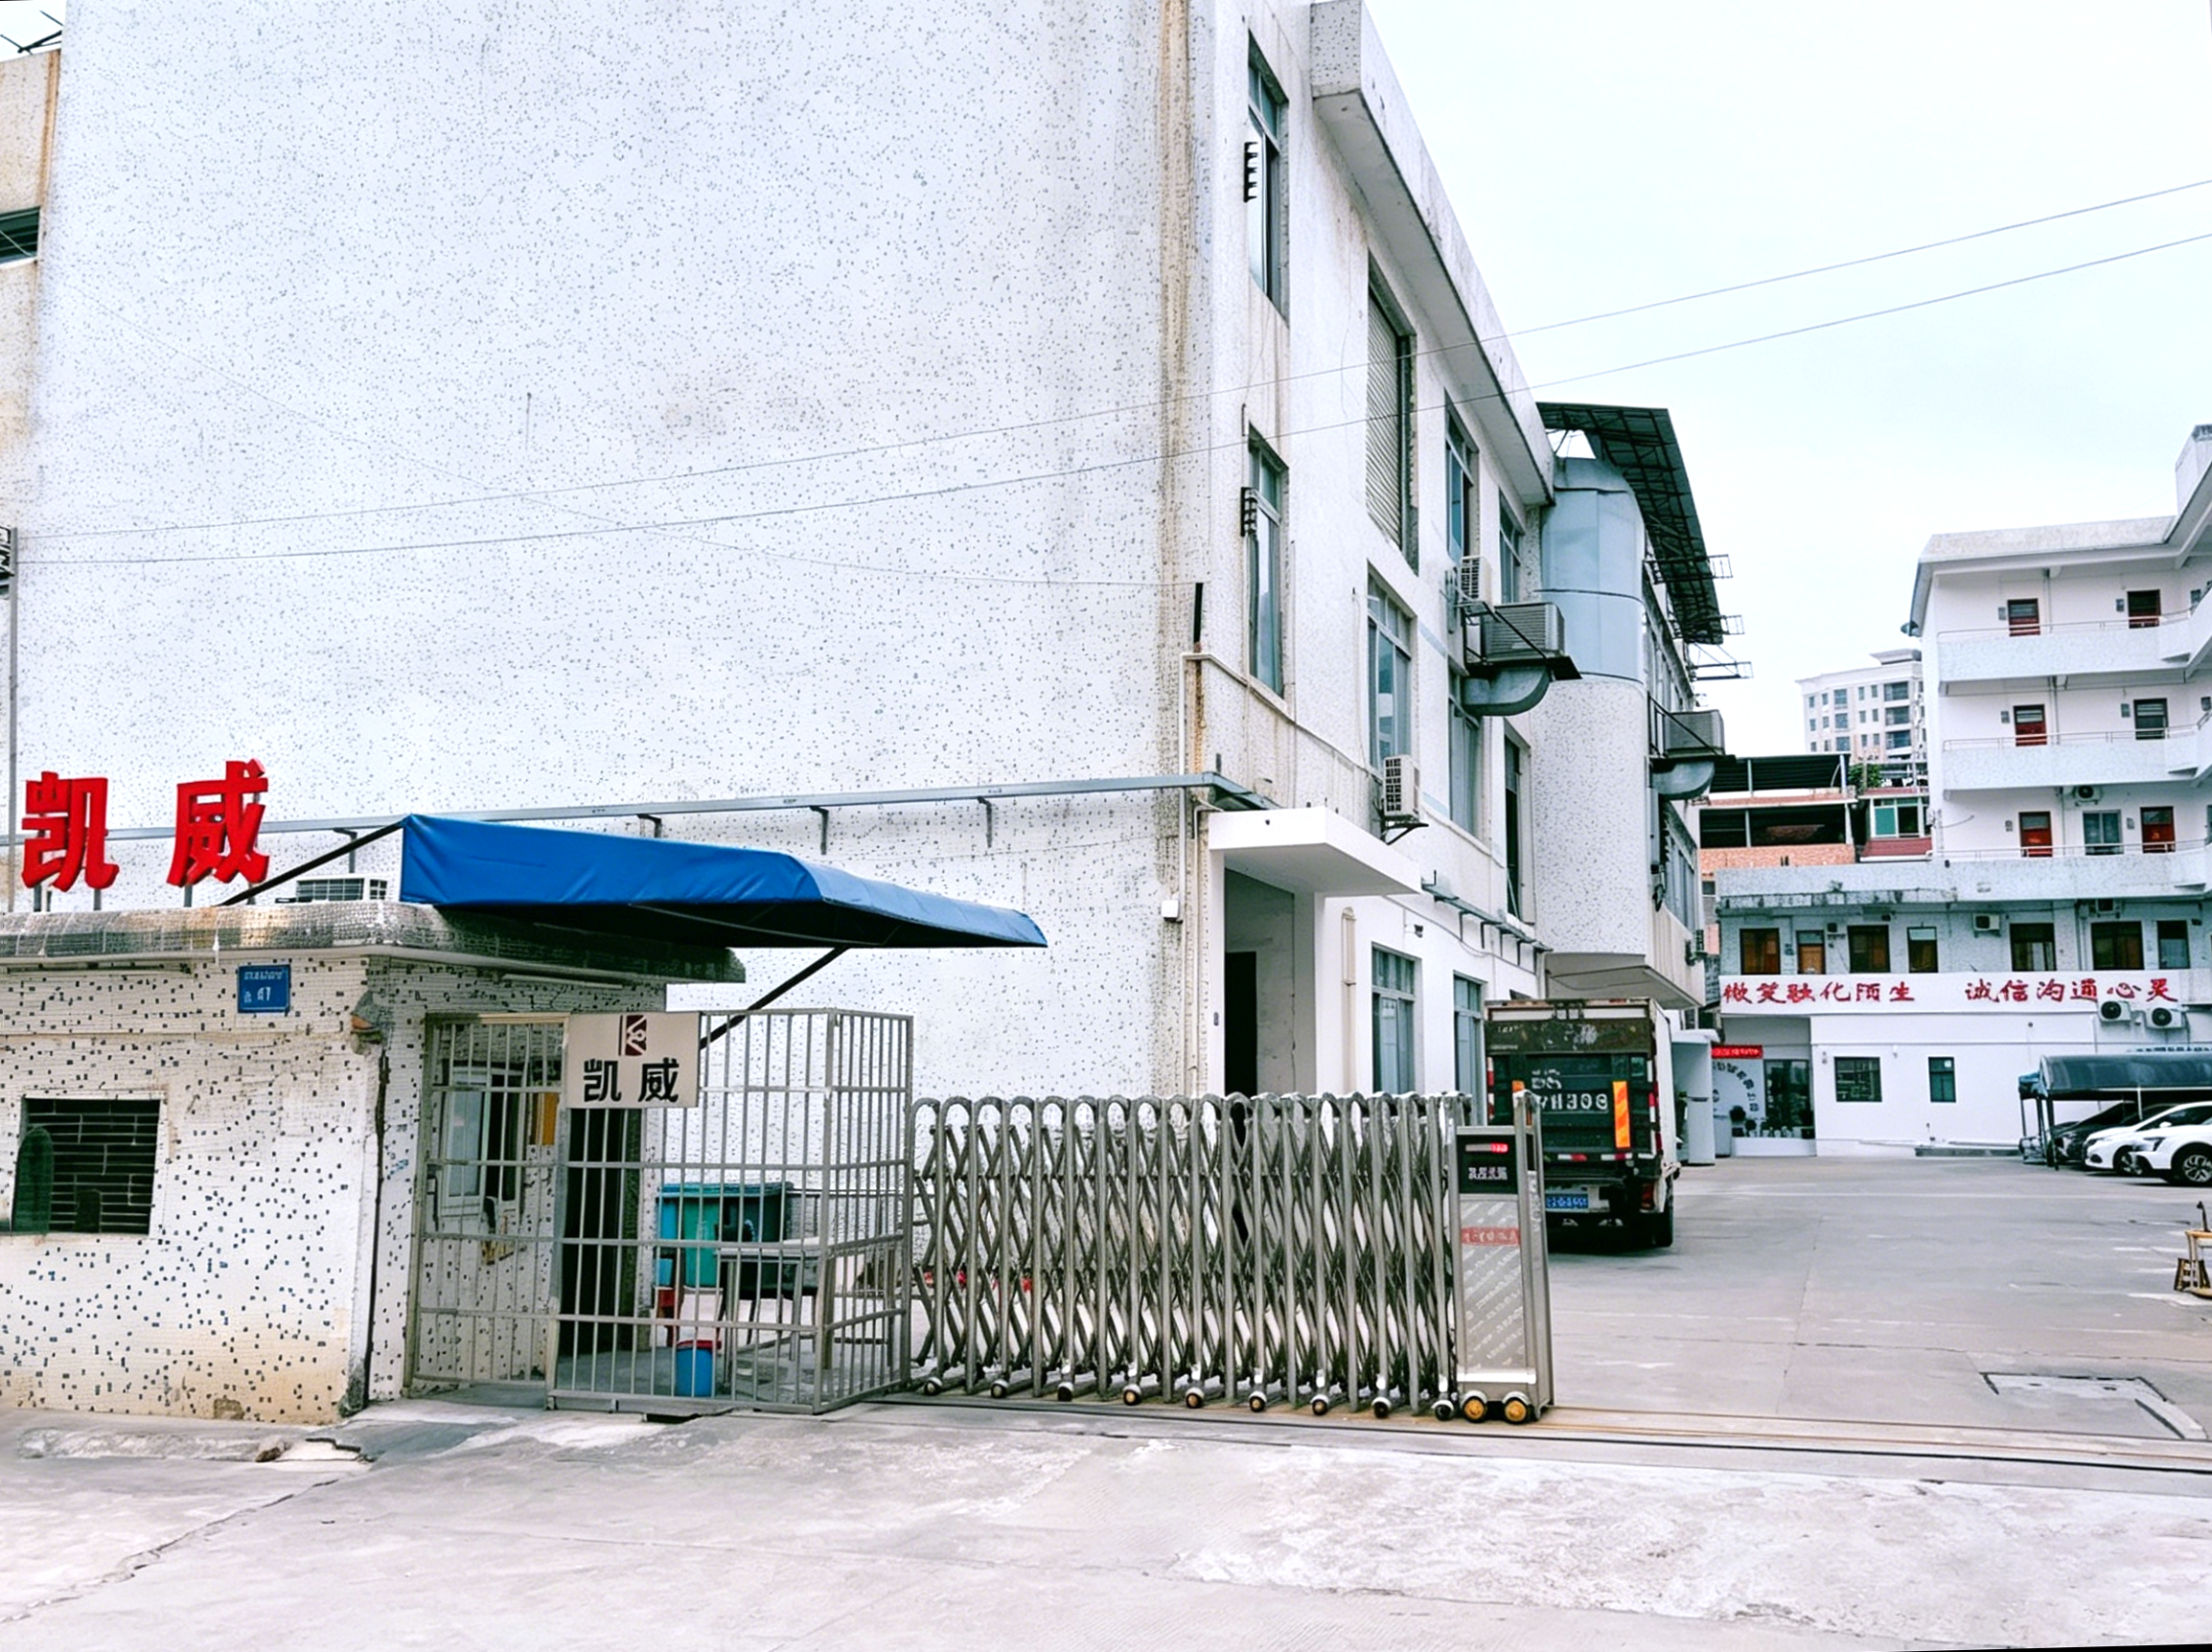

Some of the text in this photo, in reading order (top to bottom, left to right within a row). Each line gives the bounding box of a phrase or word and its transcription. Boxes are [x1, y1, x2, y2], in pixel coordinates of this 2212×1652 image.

[21, 758, 270, 891] 凯威
[1722, 977, 2178, 1004] 微笑融化陌生 诚信沟通心灵
[583, 1057, 680, 1103] 凯威
